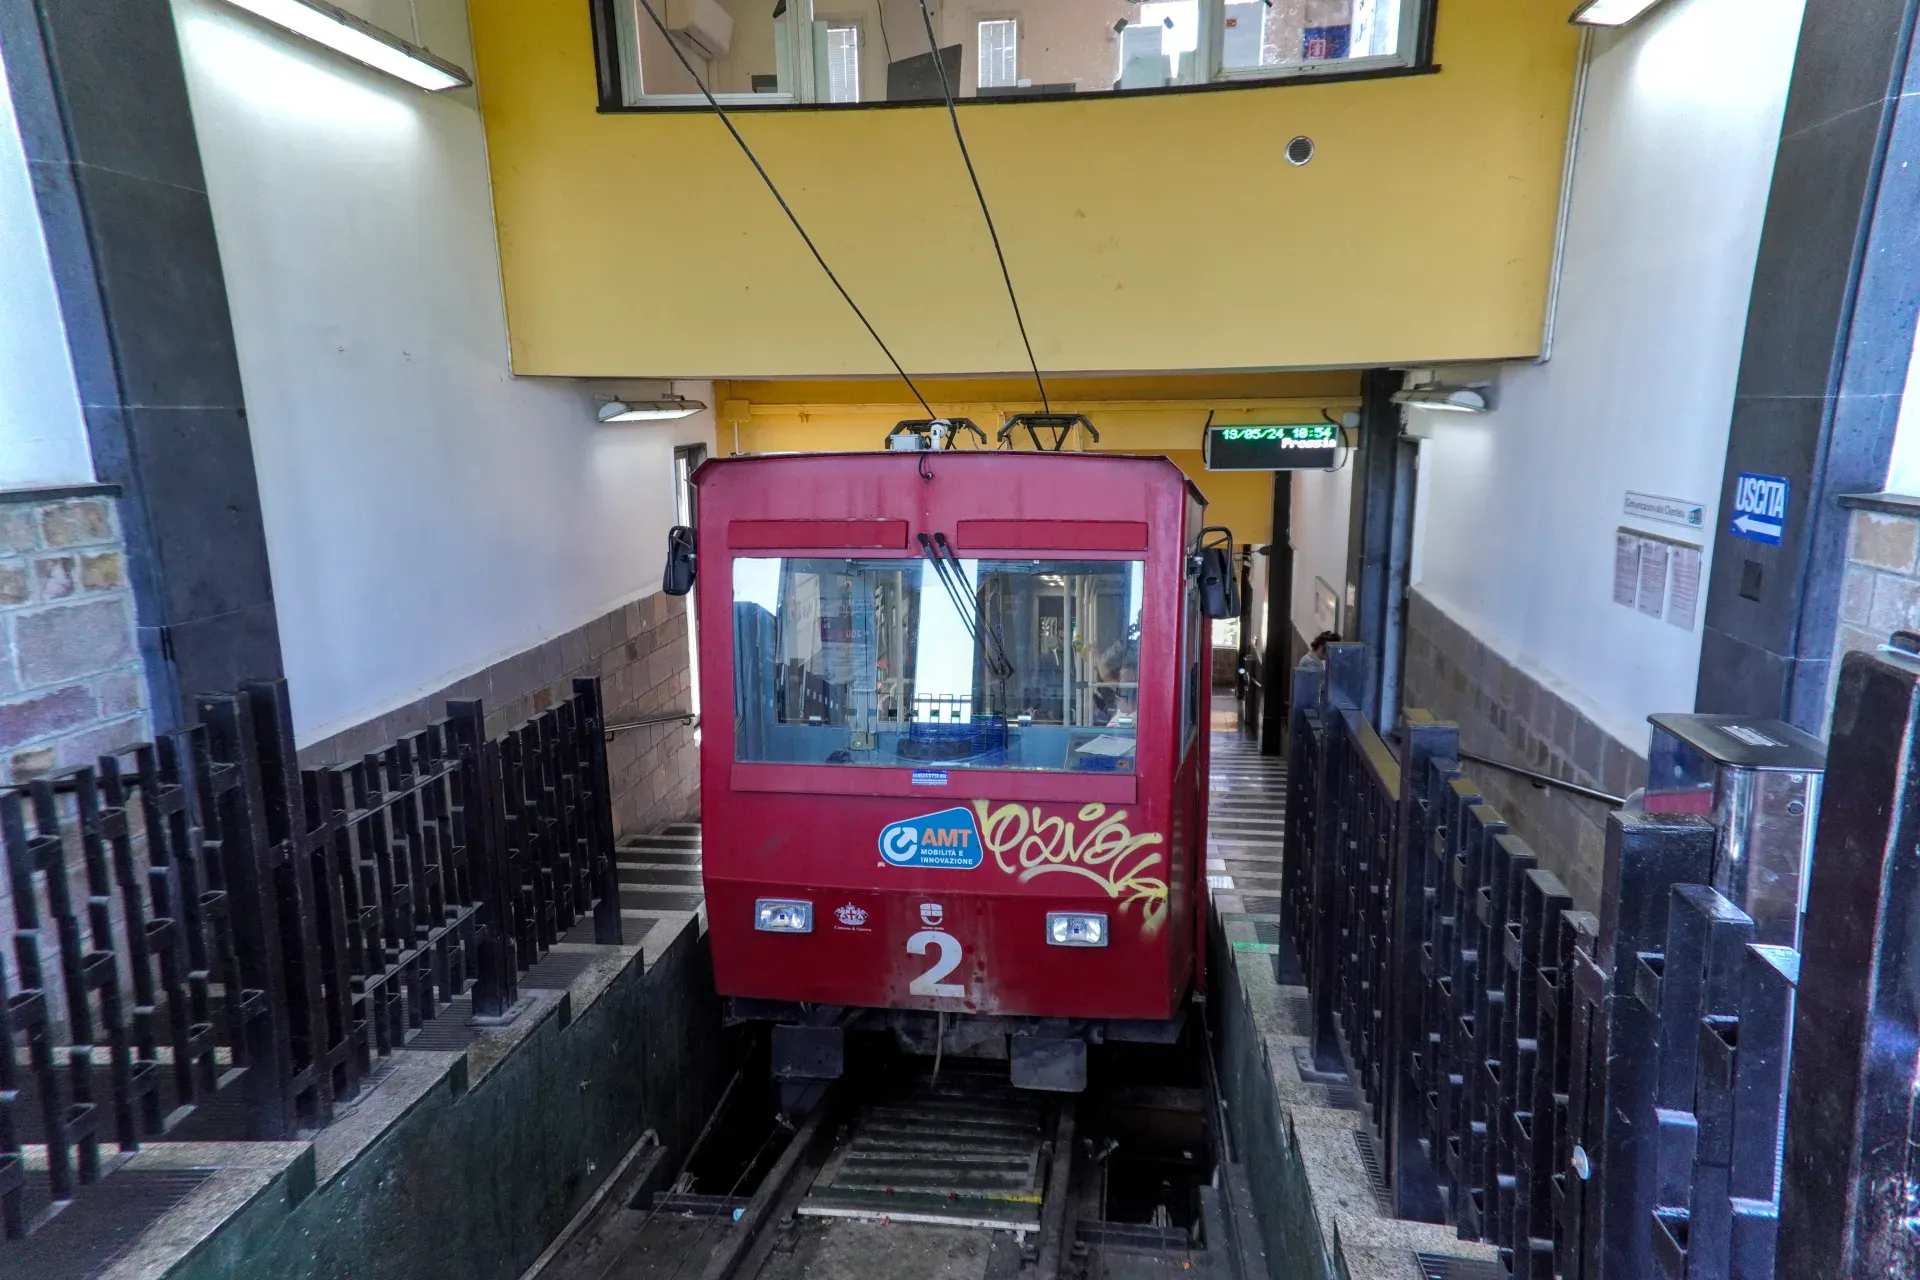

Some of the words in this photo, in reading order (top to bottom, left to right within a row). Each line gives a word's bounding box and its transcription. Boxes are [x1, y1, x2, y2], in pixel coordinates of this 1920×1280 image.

[1736, 477, 1785, 518] USCITA
[921, 828, 972, 848] AMT
[920, 848, 957, 857] MOBILITÀ
[920, 857, 973, 865] INNOVAZIONE
[906, 931, 965, 998] 2
